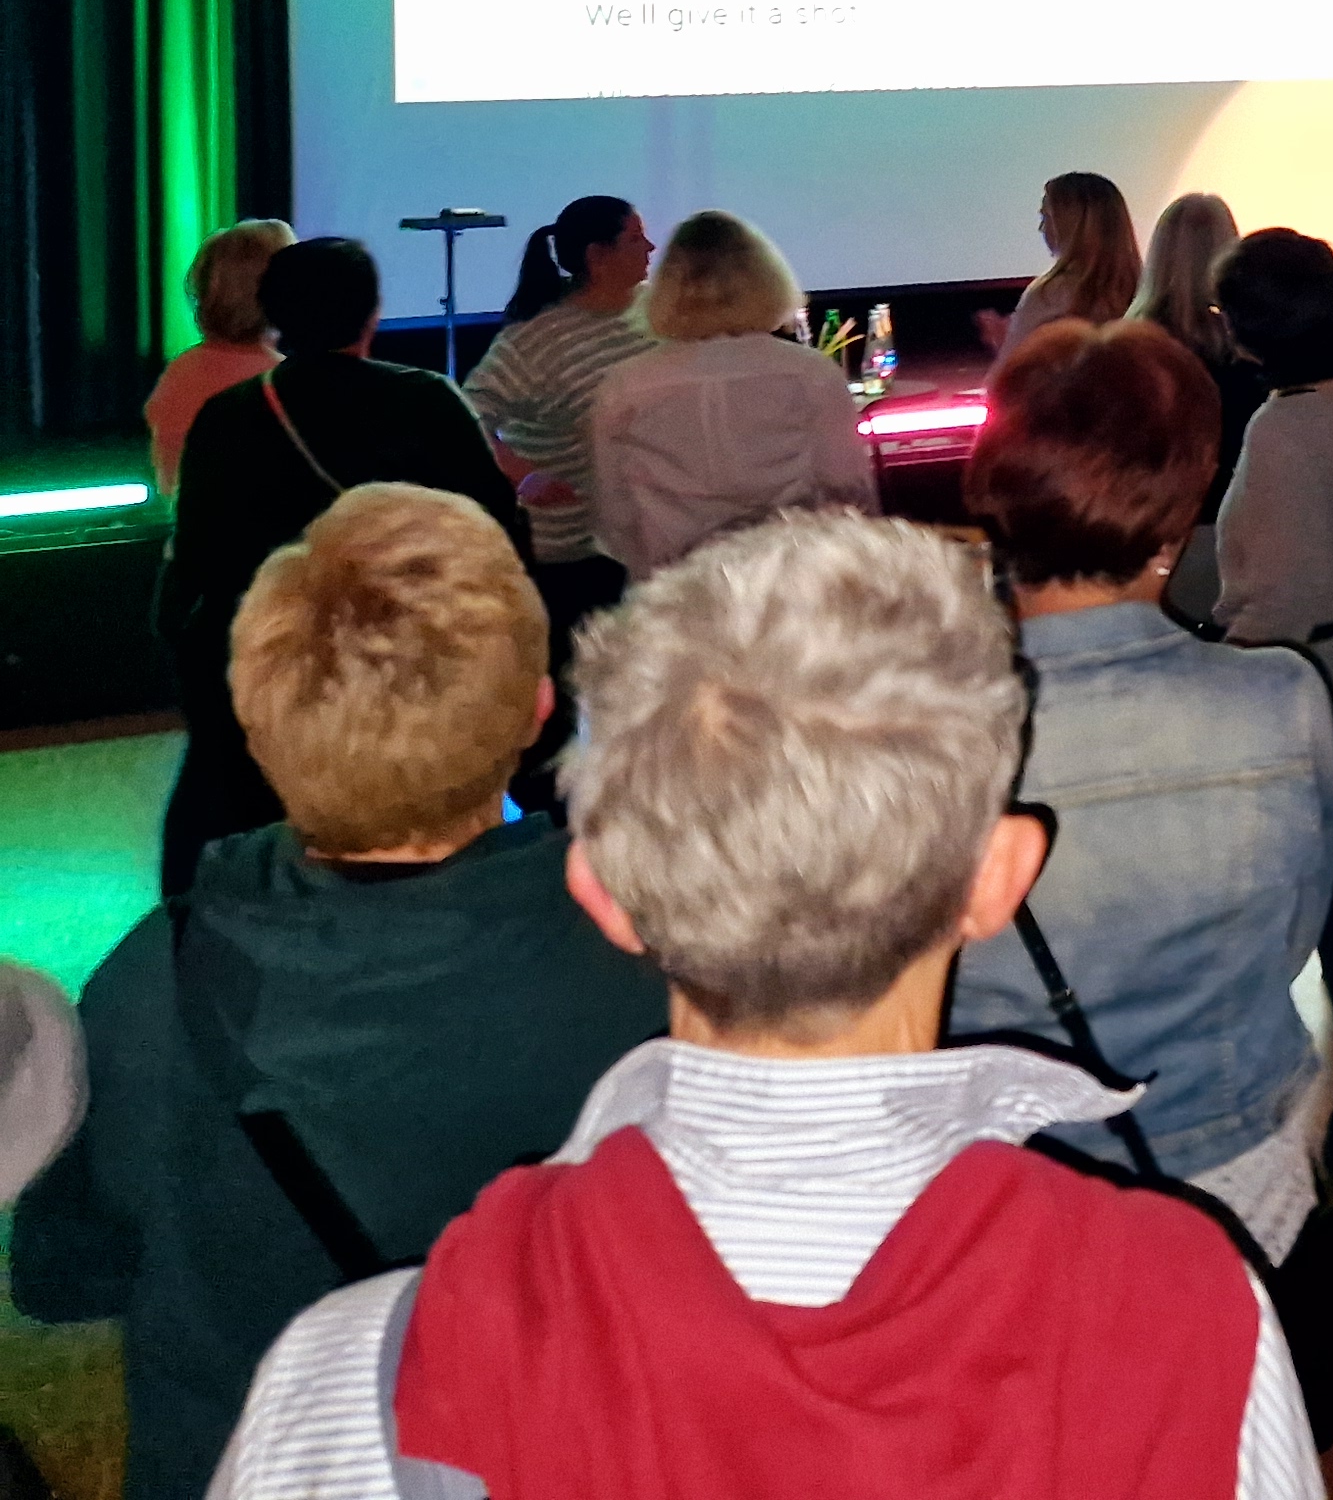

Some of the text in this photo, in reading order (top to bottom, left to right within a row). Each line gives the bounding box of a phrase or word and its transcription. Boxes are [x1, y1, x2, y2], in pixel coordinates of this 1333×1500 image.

[585, 3, 655, 27] Well
[667, 8, 728, 33] give
[740, 5, 756, 24] it
[768, 7, 782, 25] a
